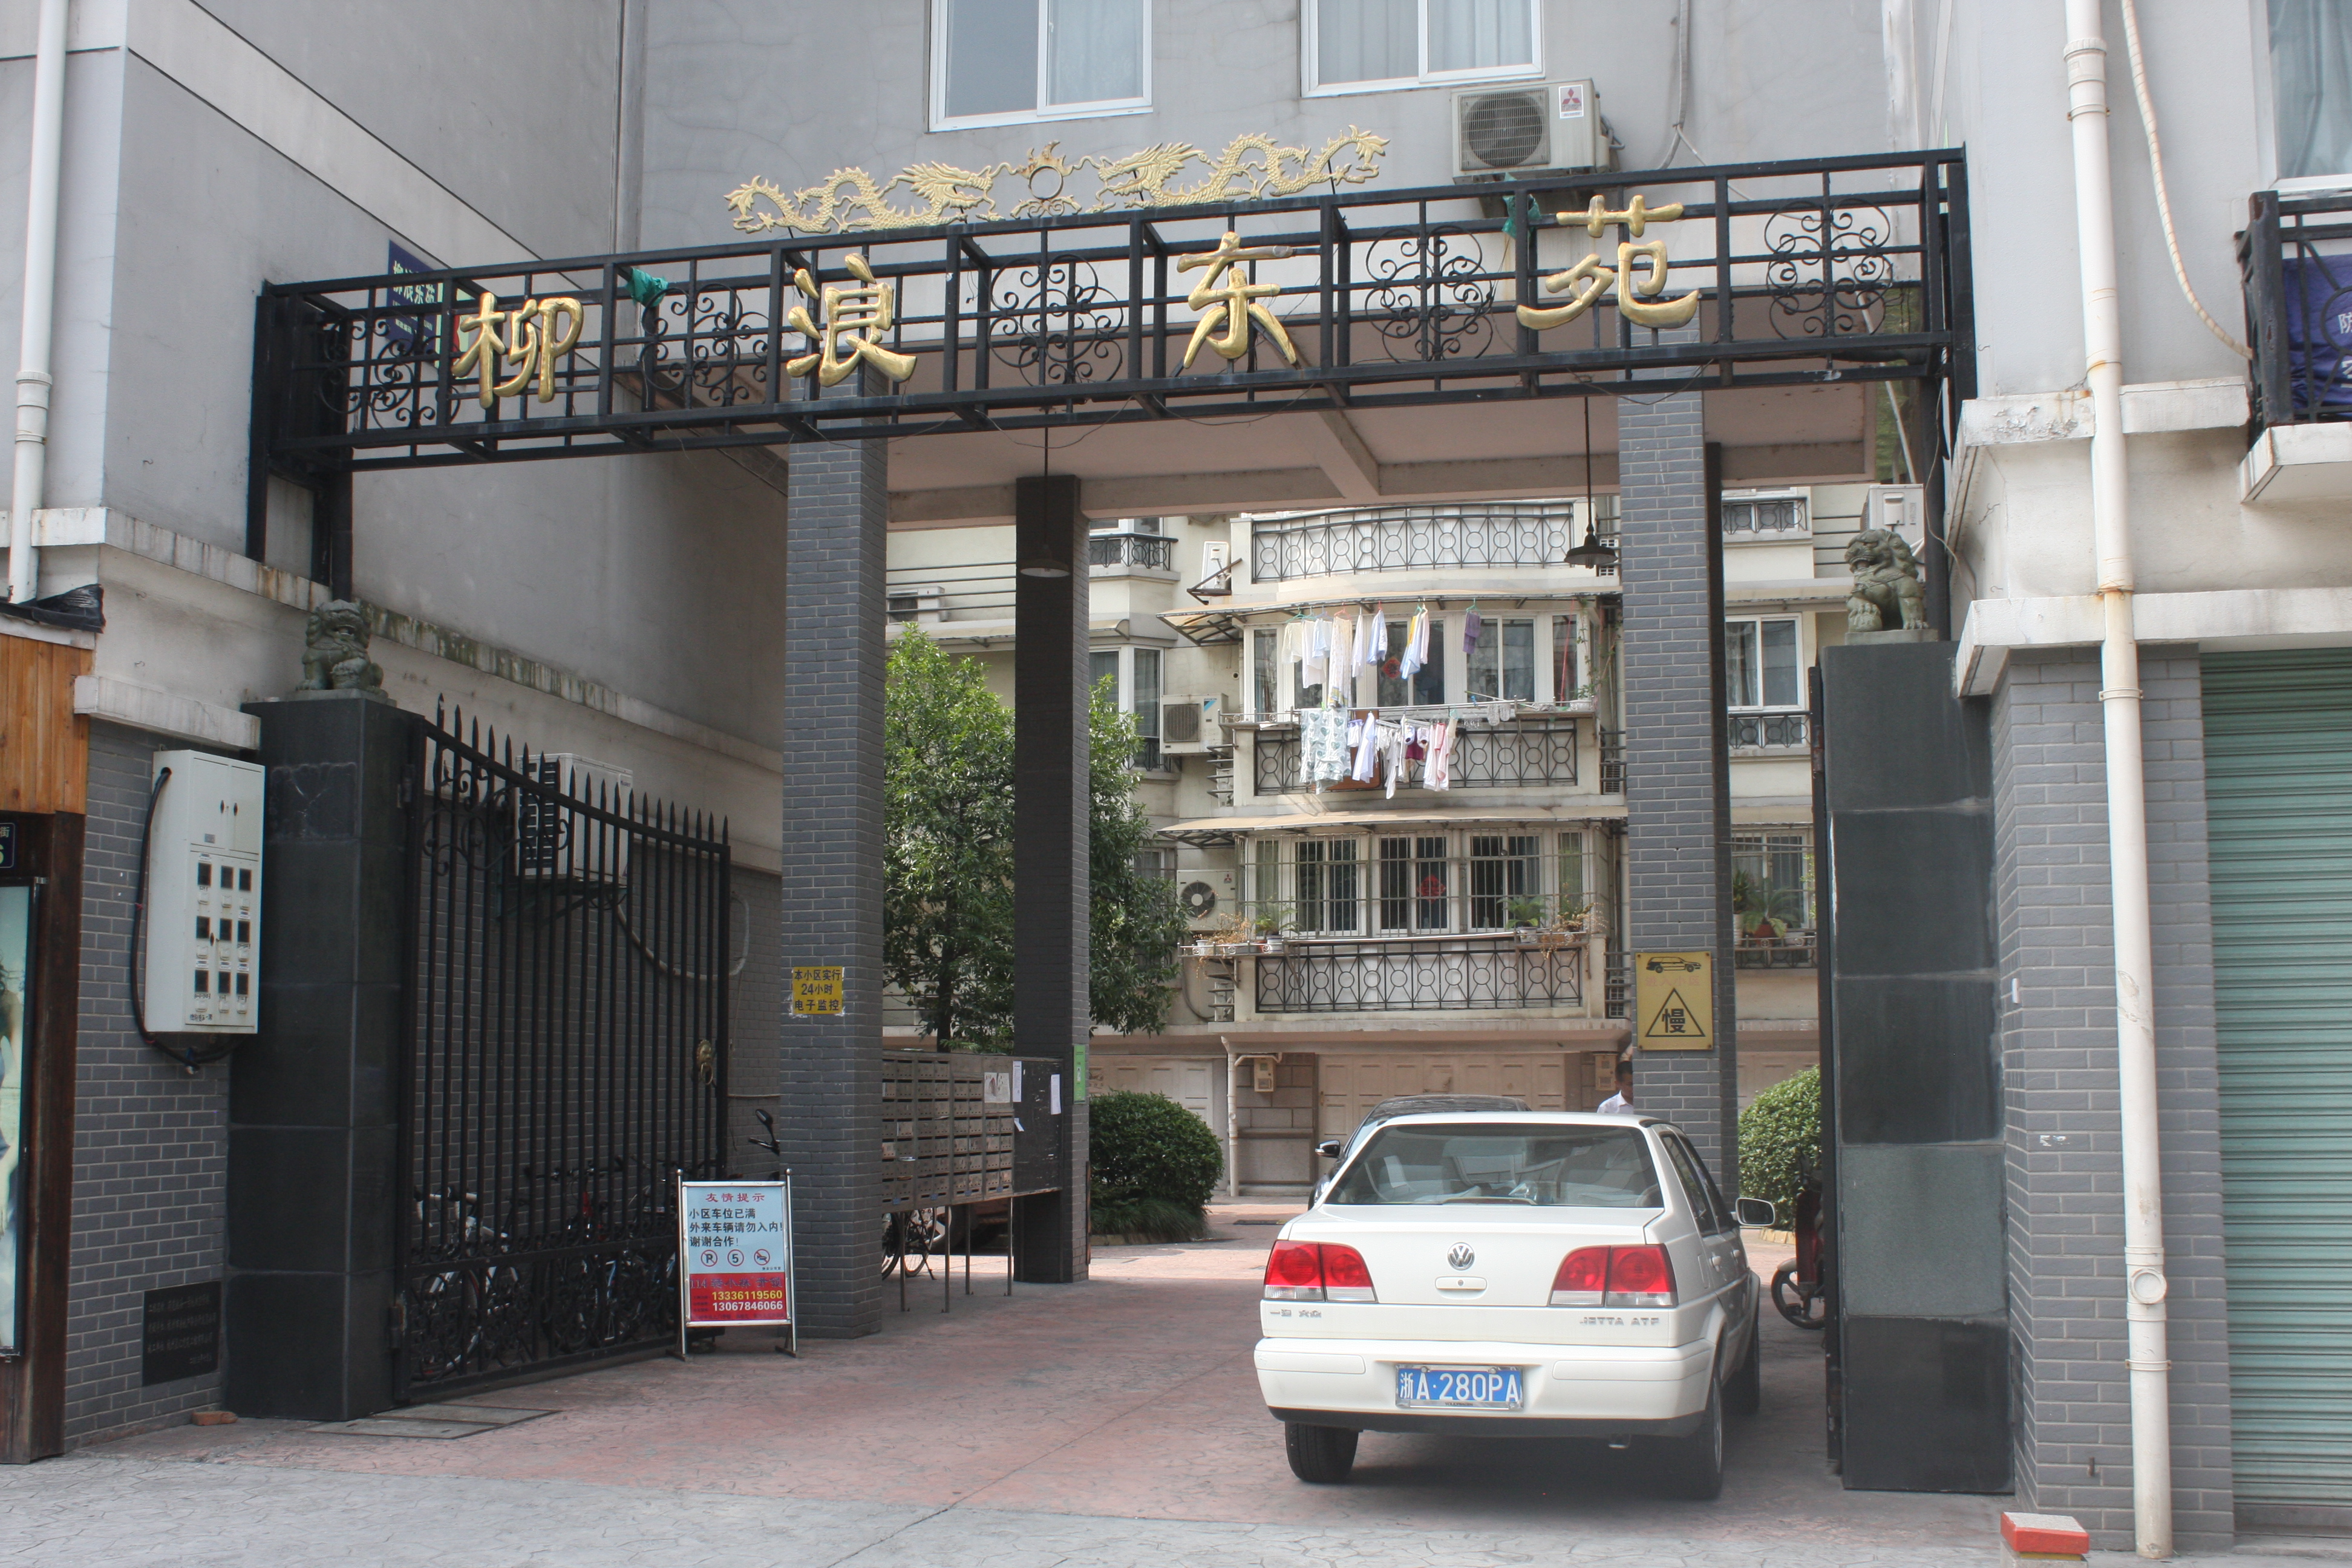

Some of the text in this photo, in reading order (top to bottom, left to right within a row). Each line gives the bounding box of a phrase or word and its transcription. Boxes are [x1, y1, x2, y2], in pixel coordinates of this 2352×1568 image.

[451, 194, 1700, 409] 柳浪东苑
[794, 969, 841, 981] 本小区实行
[801, 983, 833, 995] 24小时
[795, 999, 840, 1011] 电子监控
[1662, 1008, 1686, 1033] 慢
[705, 1193, 765, 1203] 友情提示
[689, 1207, 756, 1219] 小区车位已满
[731, 1253, 739, 1263] 5
[712, 1290, 783, 1301] 13336119560
[713, 1301, 783, 1312] 13067846066
[1579, 1316, 1625, 1325] JETTA
